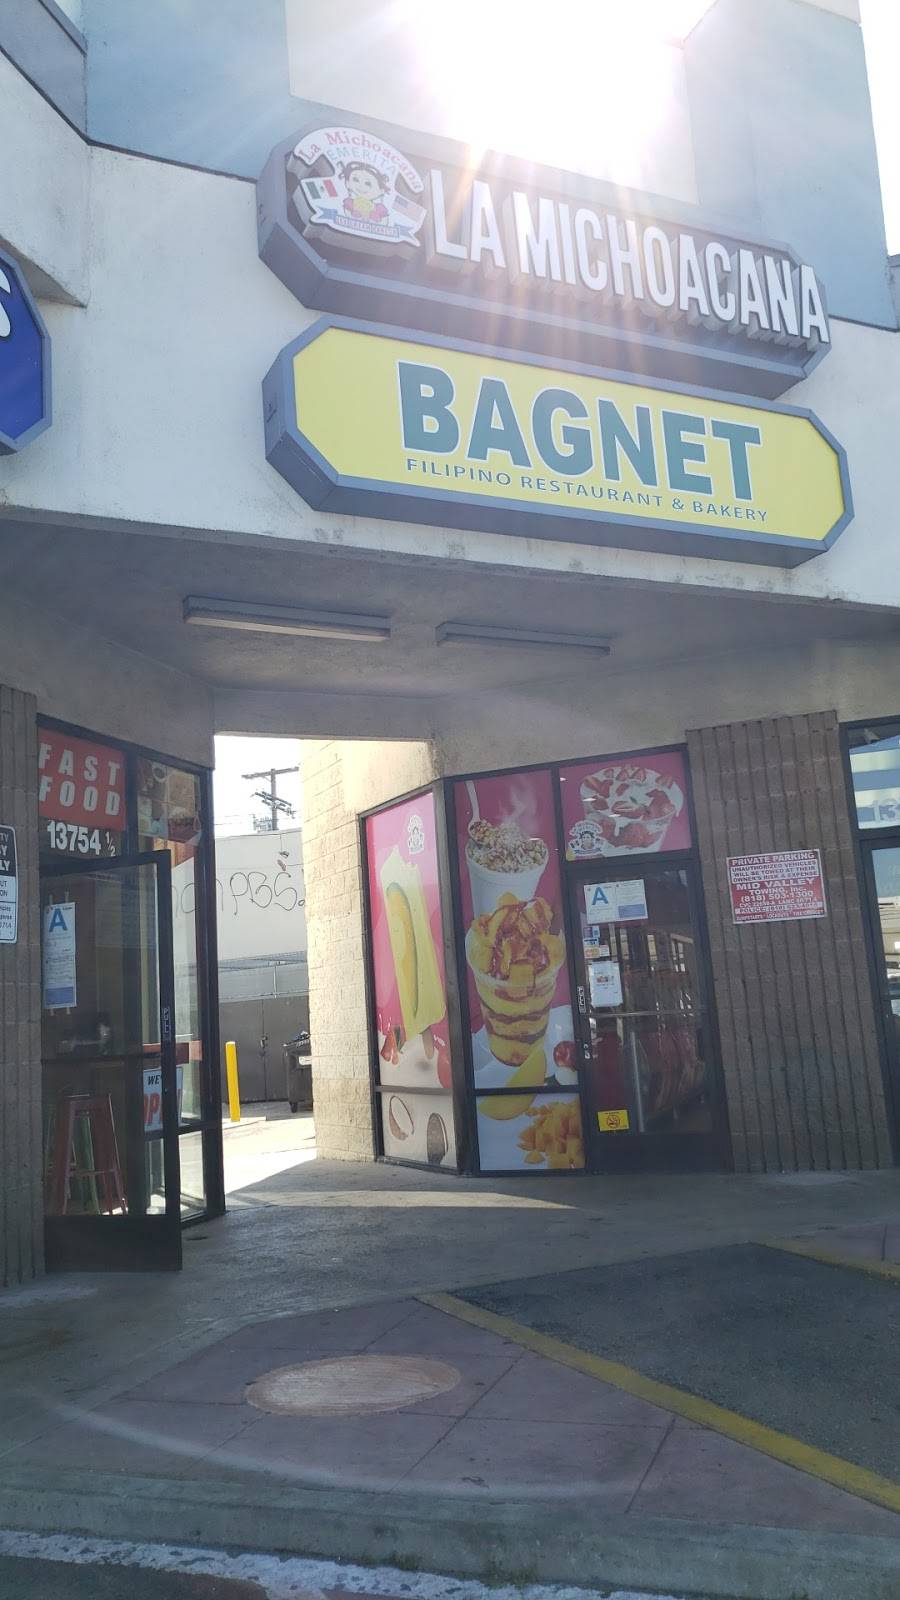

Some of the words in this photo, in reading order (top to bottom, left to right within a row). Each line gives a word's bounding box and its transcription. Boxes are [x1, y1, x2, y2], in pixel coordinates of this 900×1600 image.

[431, 169, 507, 268] LA
[513, 190, 830, 344] MICHOACANA
[397, 360, 763, 501] BAGNET
[406, 458, 512, 486] FILIPINO
[520, 476, 663, 507] RESTAURANT
[672, 498, 685, 510] &
[693, 500, 767, 522] BAKERY
[38, 743, 120, 786] FAST
[38, 775, 120, 816] FOOD
[47, 819, 101, 856] 13754
[732, 856, 771, 866] PRIVATE
[773, 852, 815, 863] PARKING
[732, 863, 782, 873] UNAUTHORIZED
[785, 860, 817, 868] VEHICLES
[592, 886, 608, 906] A
[736, 882, 760, 891] MID
[765, 877, 815, 888] VALLEY
[741, 894, 766, 903] (818)
[49, 908, 68, 933] A
